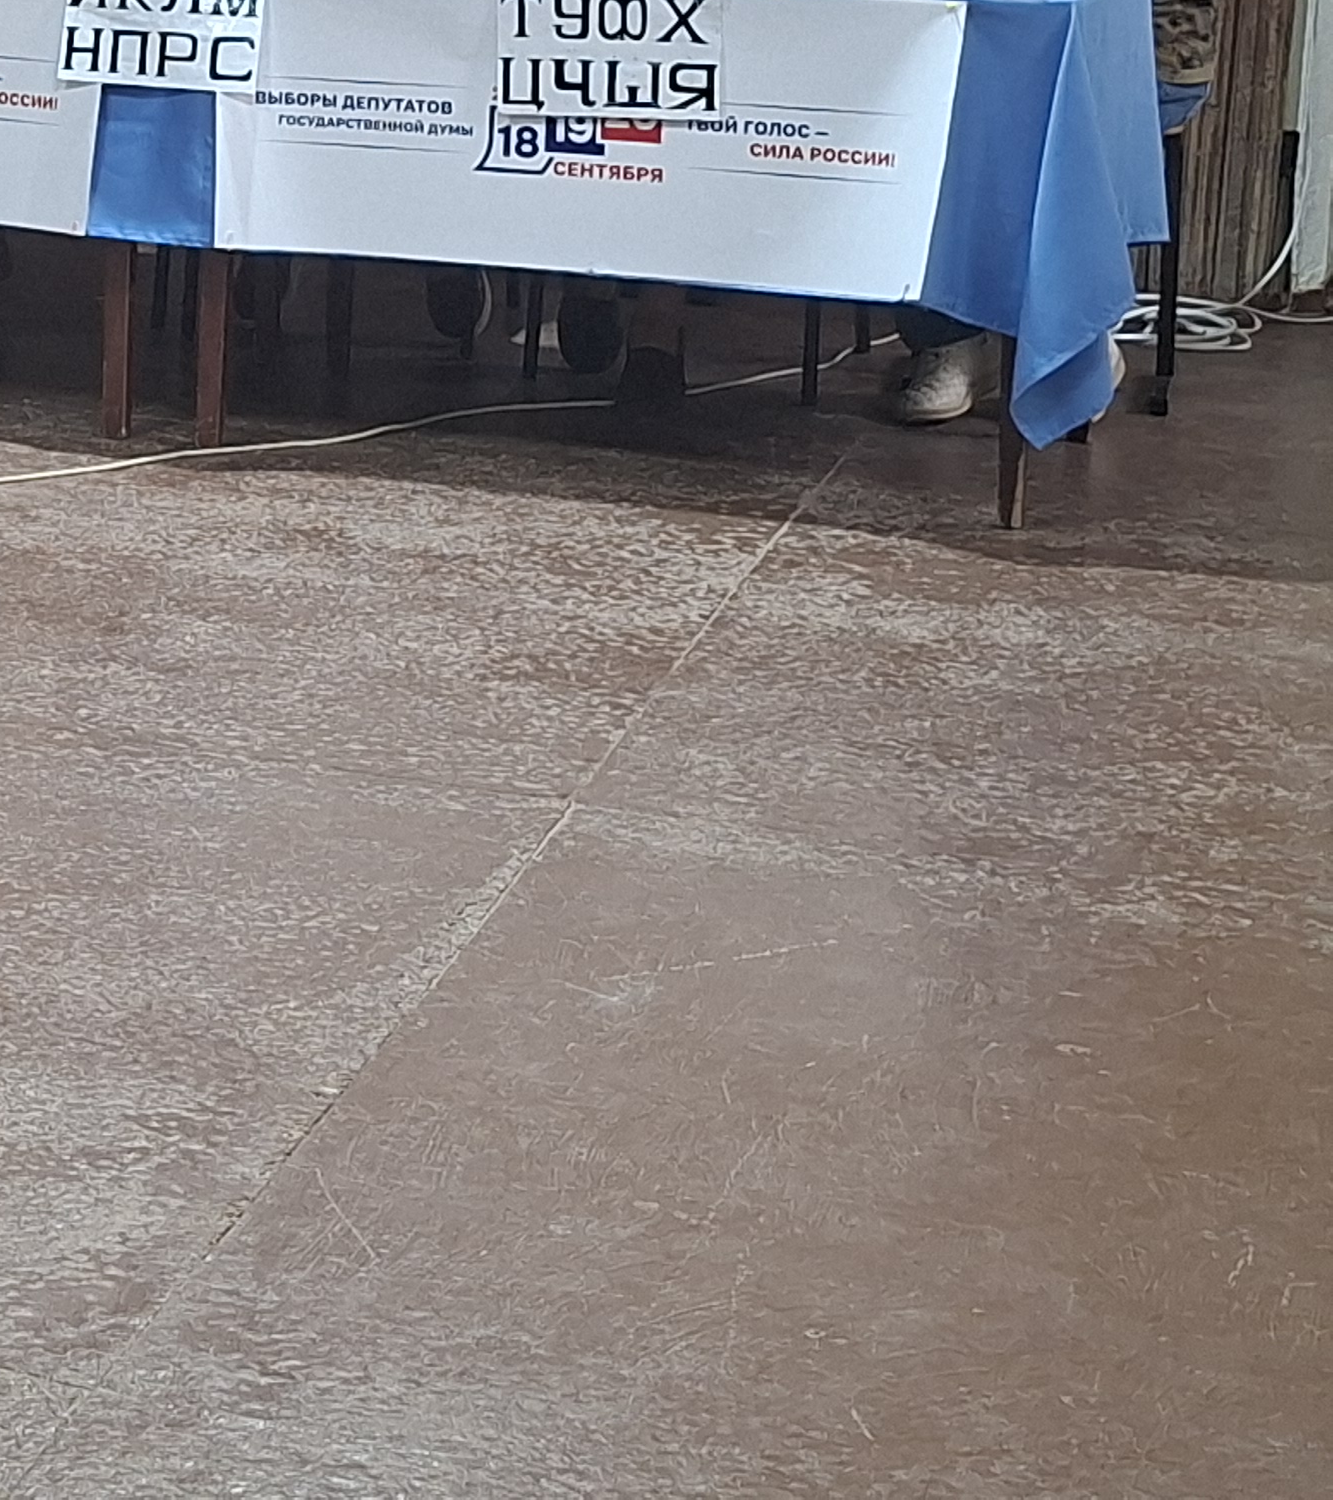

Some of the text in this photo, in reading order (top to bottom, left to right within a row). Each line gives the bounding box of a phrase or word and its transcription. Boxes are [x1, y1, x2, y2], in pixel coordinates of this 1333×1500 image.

[61, 26, 256, 81] НПРС
[255, 91, 453, 114] ВЫБОРЫ ДЕПУТАТОВ
[278, 114, 473, 137] ГОСУДАРСТВЕННОЙ ДУМЫ
[498, 125, 539, 157] 18
[555, 117, 596, 144] 19
[744, 120, 810, 138] ГОЛОС
[750, 143, 895, 168] СИЛА РОССИИ!
[553, 161, 663, 182] СЕНТЯБРЯ
